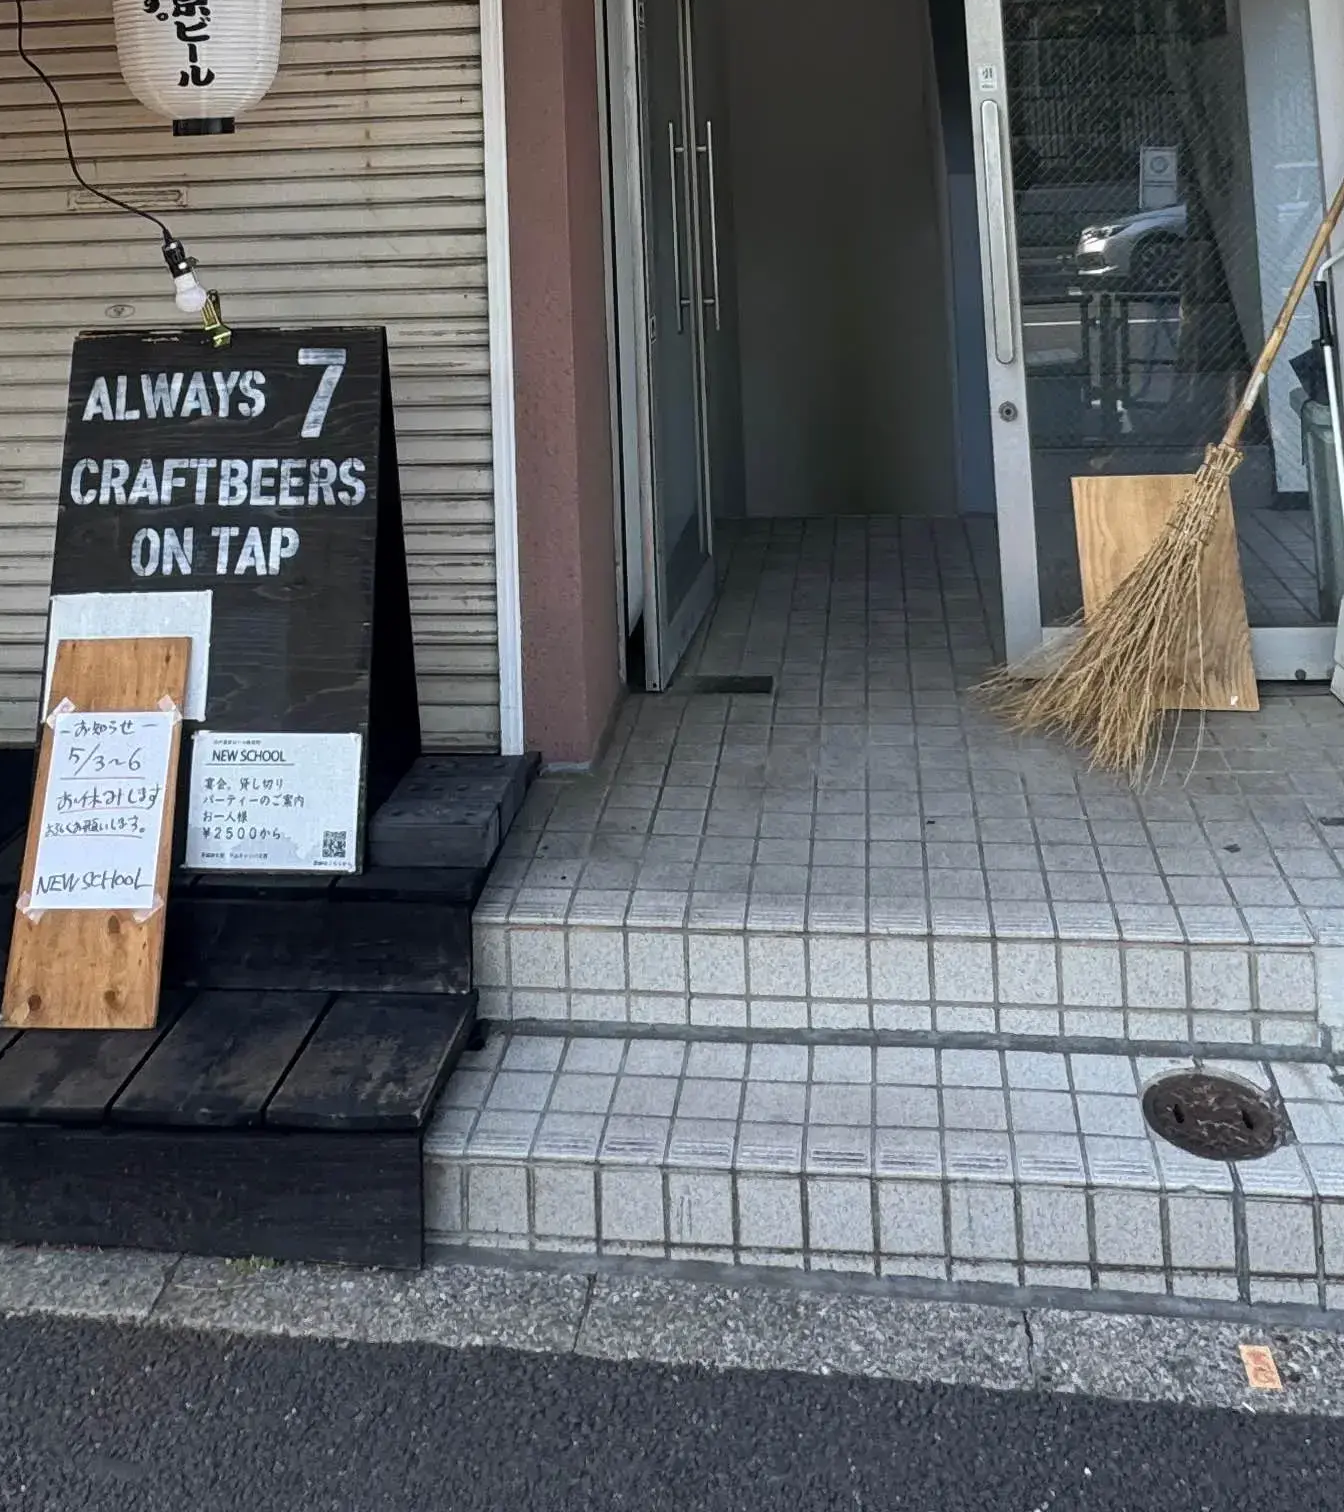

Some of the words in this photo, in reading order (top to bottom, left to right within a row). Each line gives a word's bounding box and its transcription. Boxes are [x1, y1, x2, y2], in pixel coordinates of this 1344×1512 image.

[82, 370, 267, 422] ALWAYS
[297, 347, 347, 438] 7
[69, 456, 367, 507] CRAFTBEERS
[130, 526, 195, 577] ON
[210, 525, 301, 576] TAP
[212, 749, 238, 762] NEW
[240, 749, 287, 762] SCHOOL
[203, 793, 305, 808] パーティーのご案内
[203, 810, 248, 823] お一人様
[36, 872, 81, 896] NEW
[80, 867, 153, 891] SCHOOL
